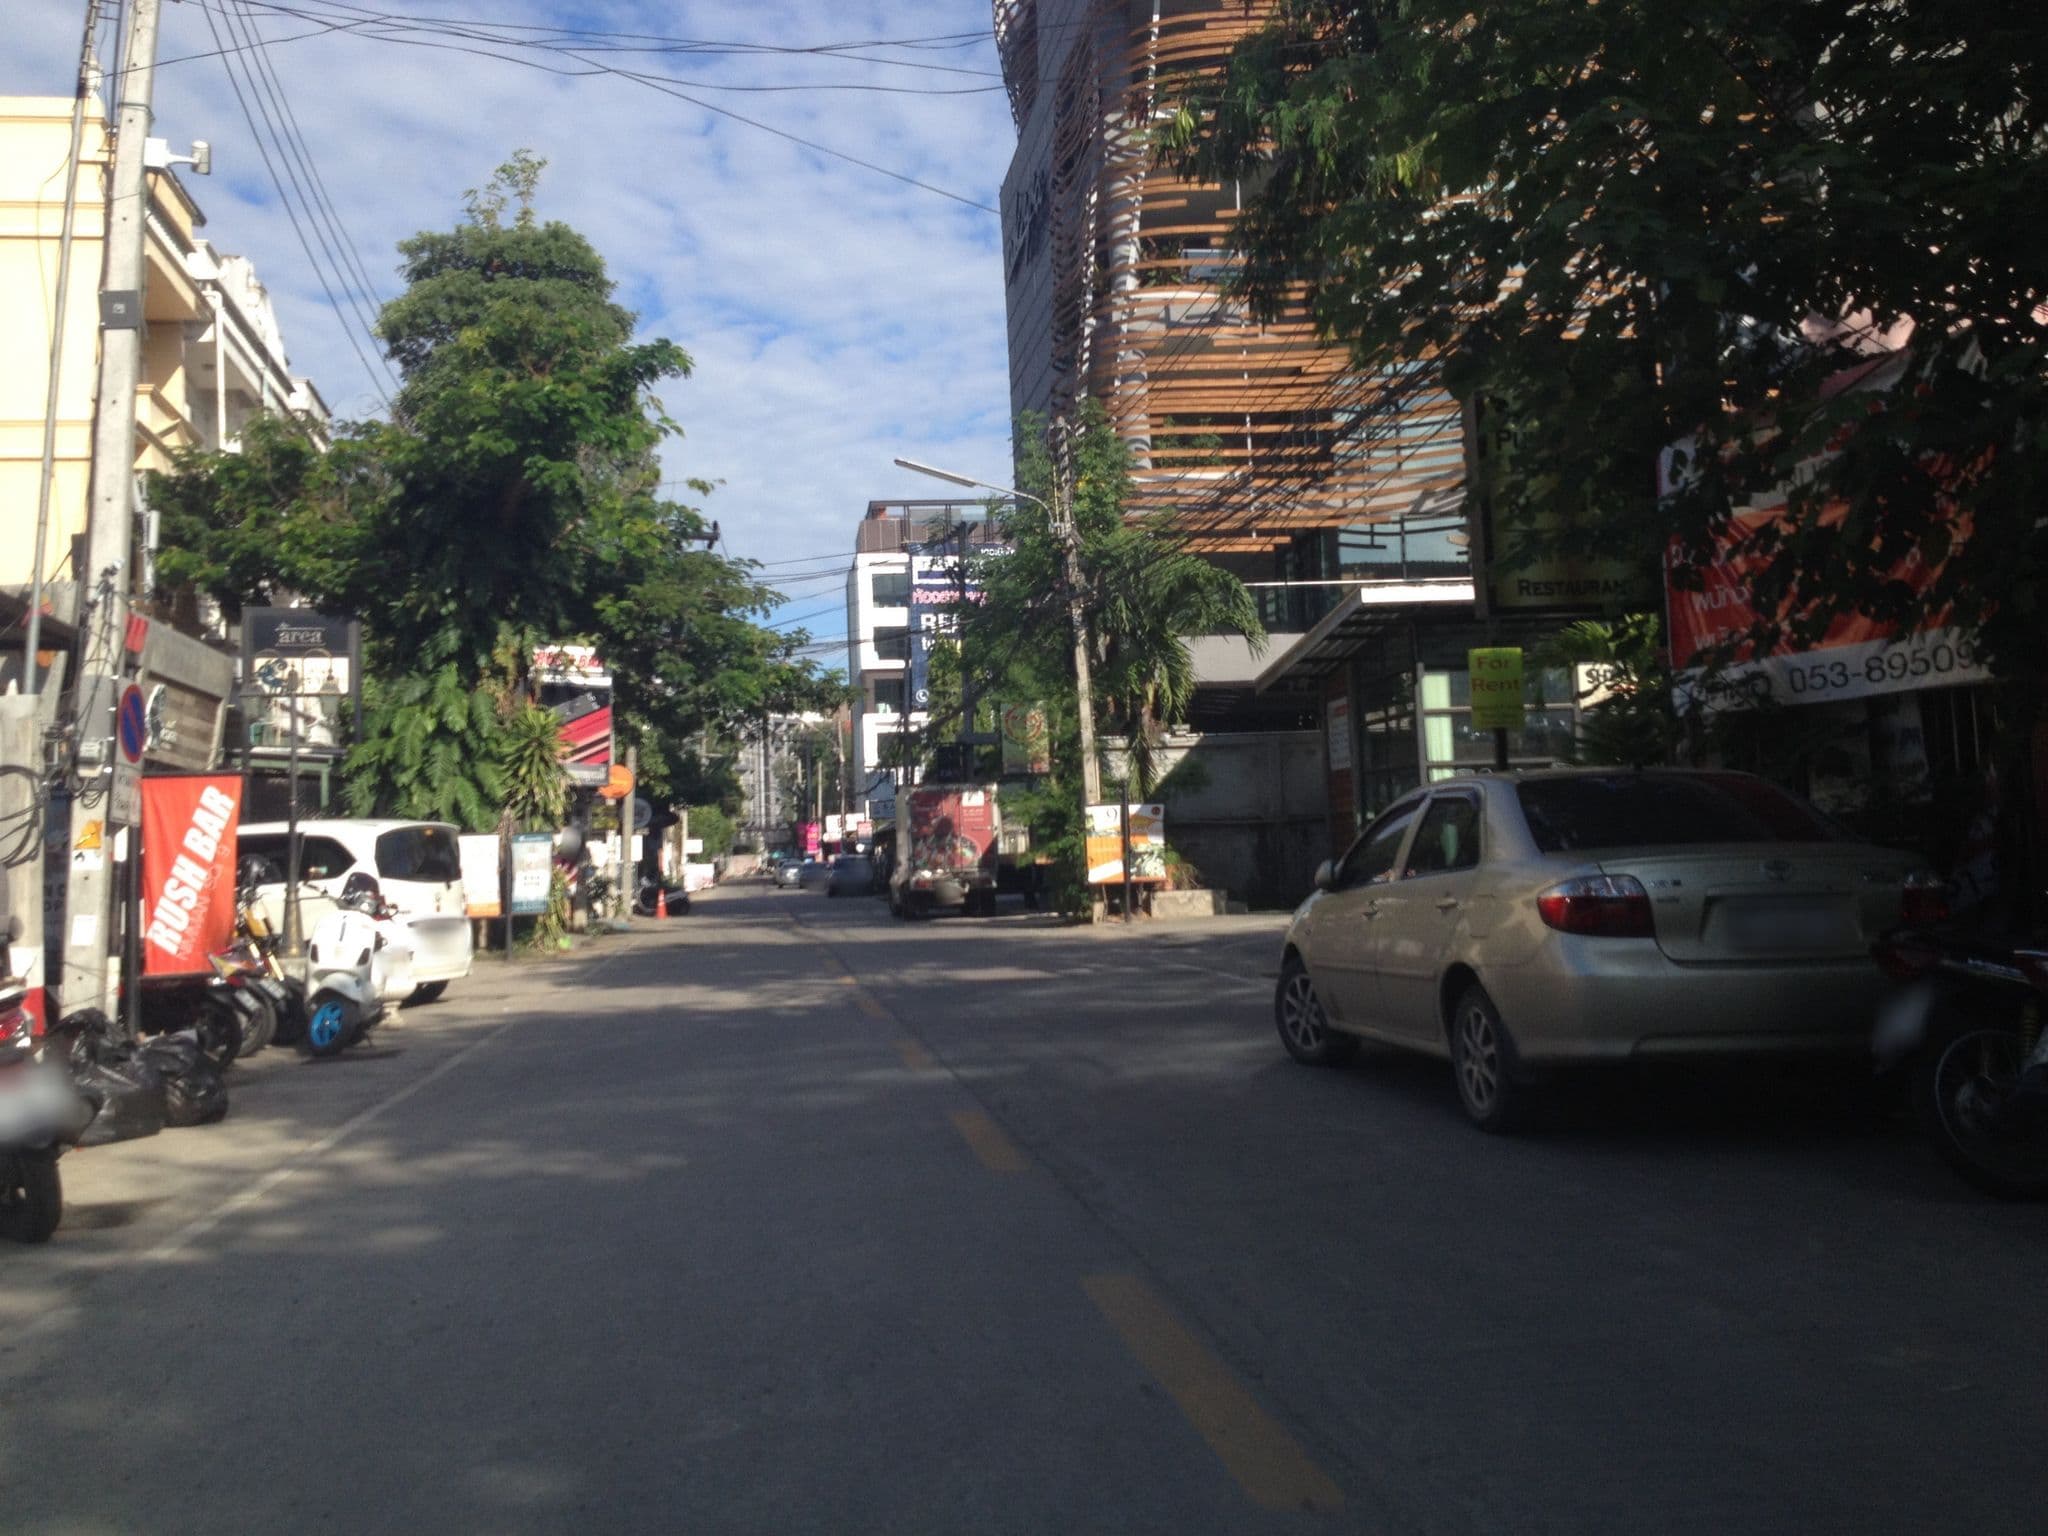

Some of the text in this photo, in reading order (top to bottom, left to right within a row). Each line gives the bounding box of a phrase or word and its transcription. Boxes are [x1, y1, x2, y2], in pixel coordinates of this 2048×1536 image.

[1476, 655, 1510, 670] For
[1788, 640, 1980, 696] 053-89509
[1472, 678, 1521, 692] Rent
[145, 785, 235, 956] RUSH BAR
